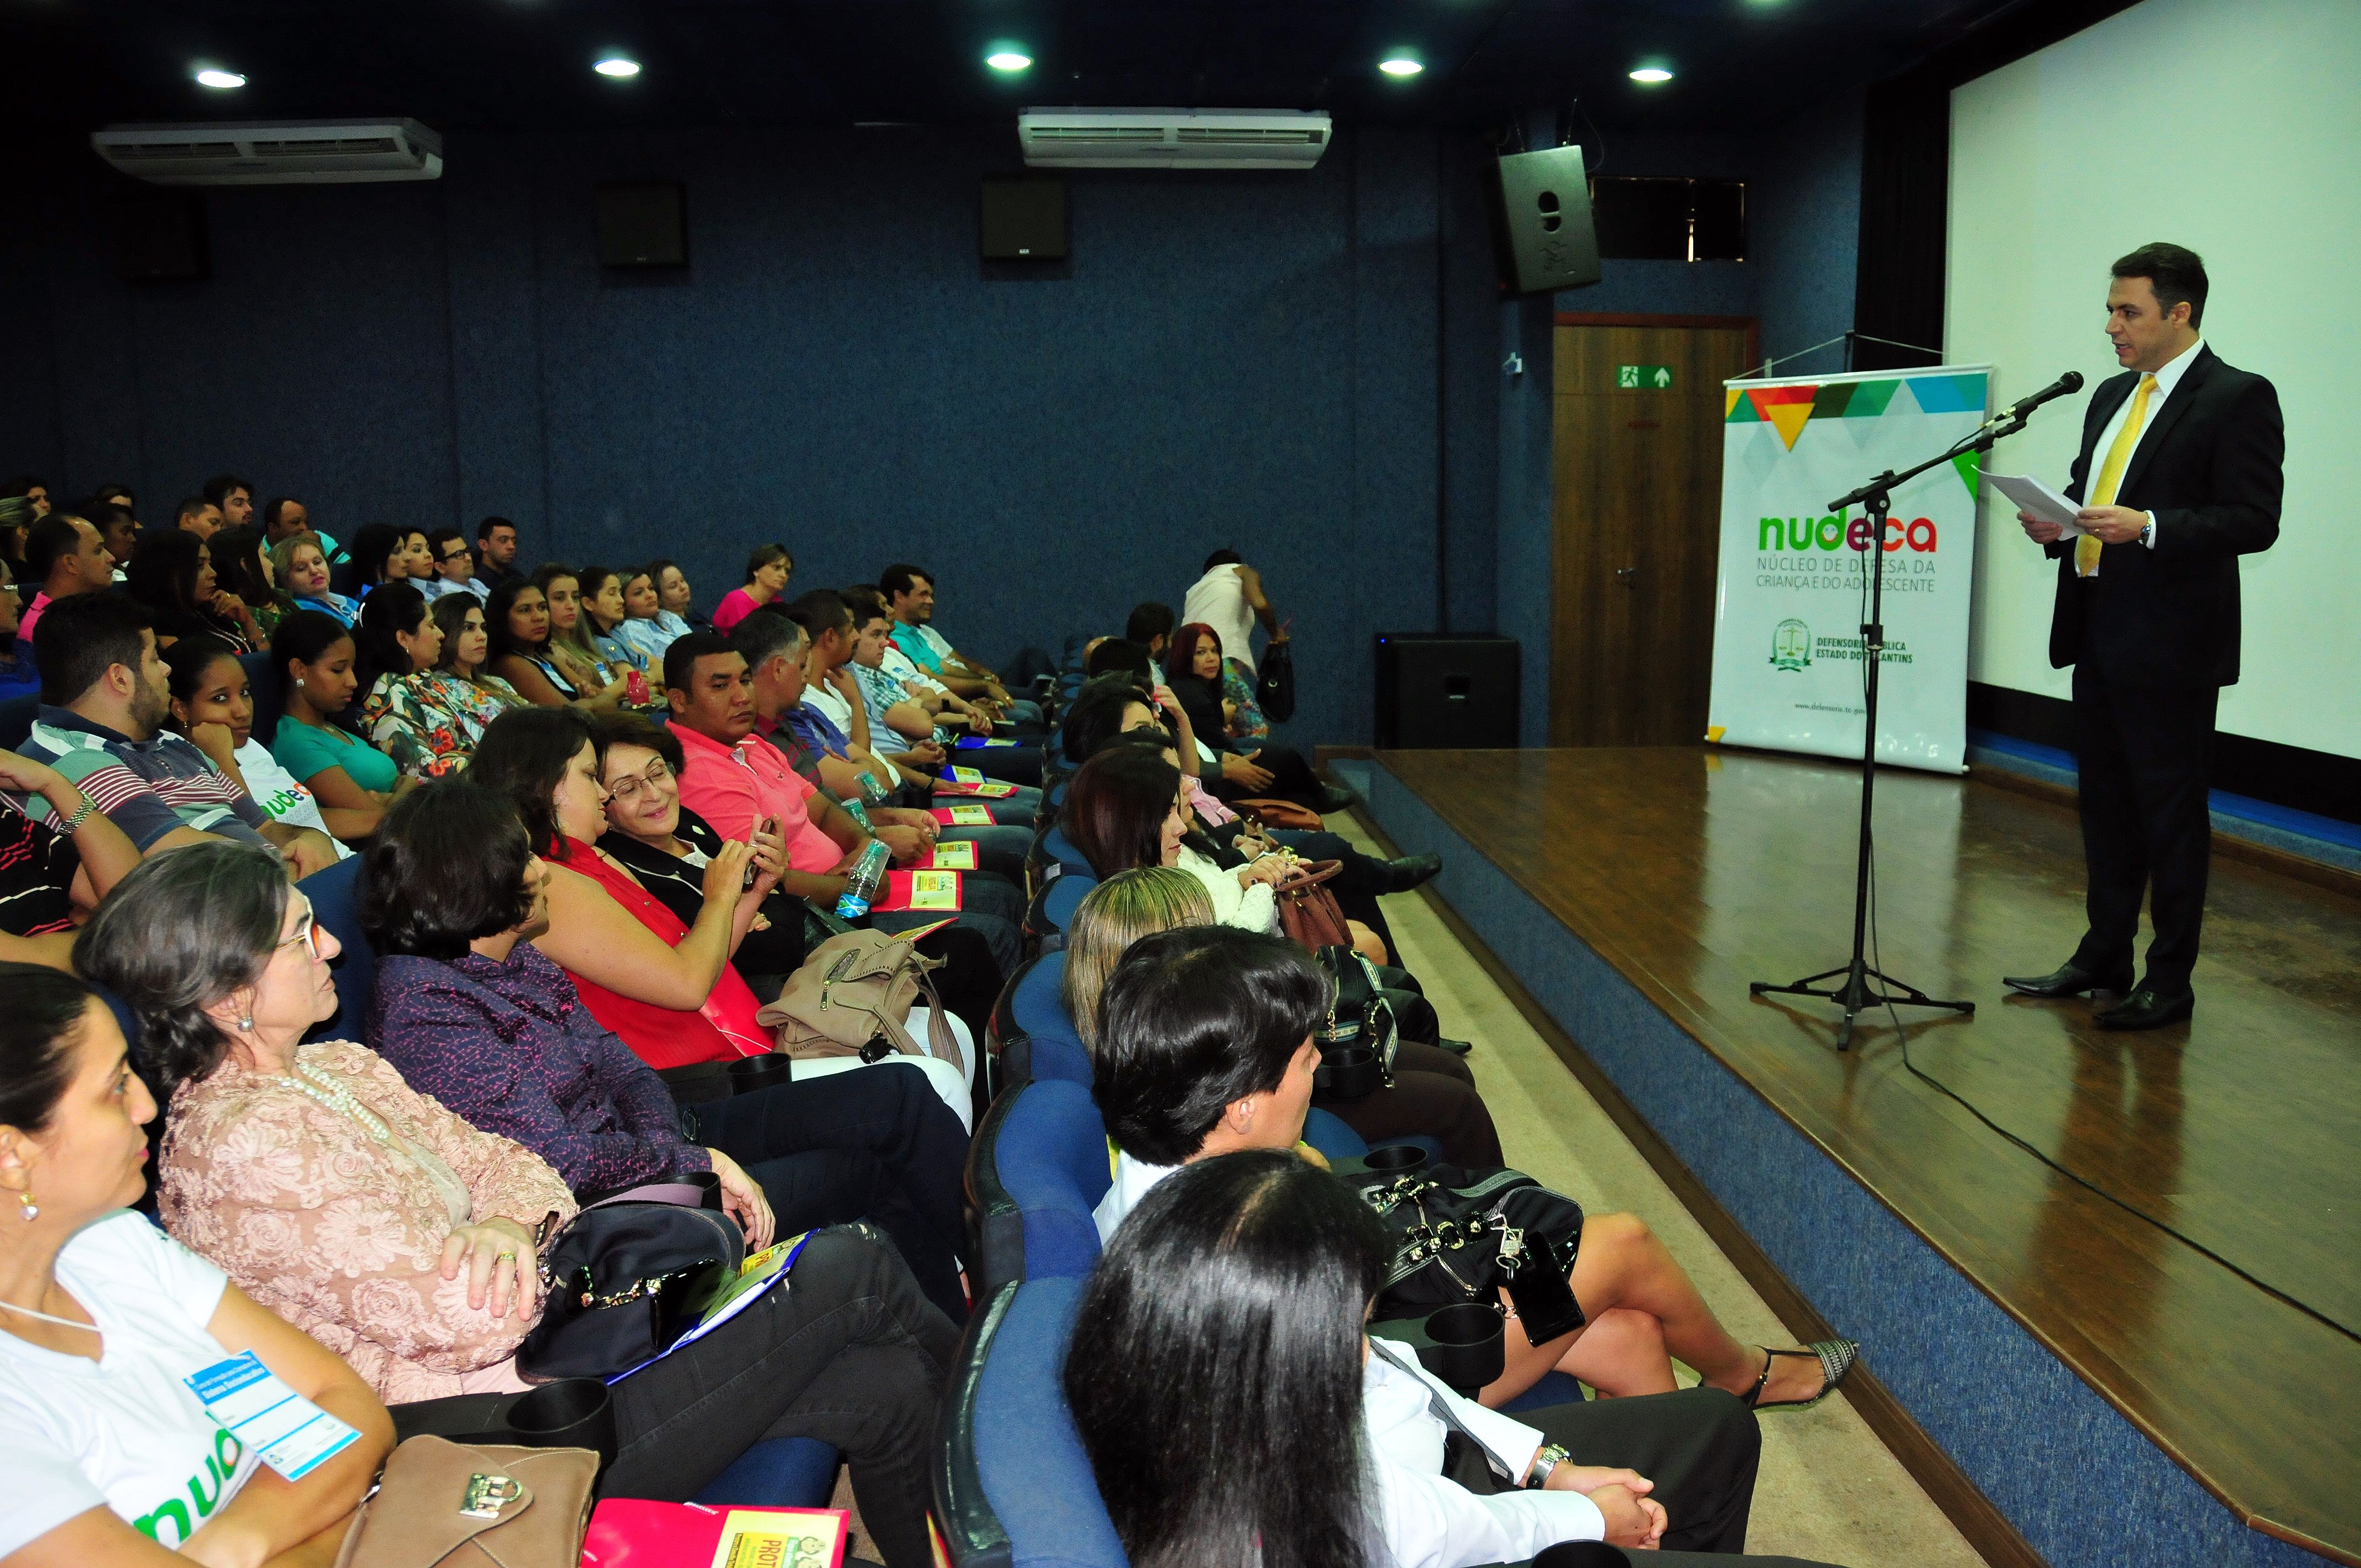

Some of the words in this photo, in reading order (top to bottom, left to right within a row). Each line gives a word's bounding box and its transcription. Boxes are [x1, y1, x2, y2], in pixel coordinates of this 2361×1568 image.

[1759, 507, 1937, 553] nudeca
[1757, 554, 1817, 571] NÚCLEO
[1823, 558, 1842, 571] DE
[1914, 559, 1935, 574] DA
[1757, 575, 1810, 591] CRIANÇA
[1814, 576, 1819, 589] E
[1823, 576, 1841, 589] DO
[1845, 577, 1935, 592] ADOESCENTE
[1882, 640, 1906, 651] BLICA
[1816, 649, 1848, 659] ESTADO
[1851, 651, 1863, 660] DO
[1864, 652, 1913, 664] TANTINS
